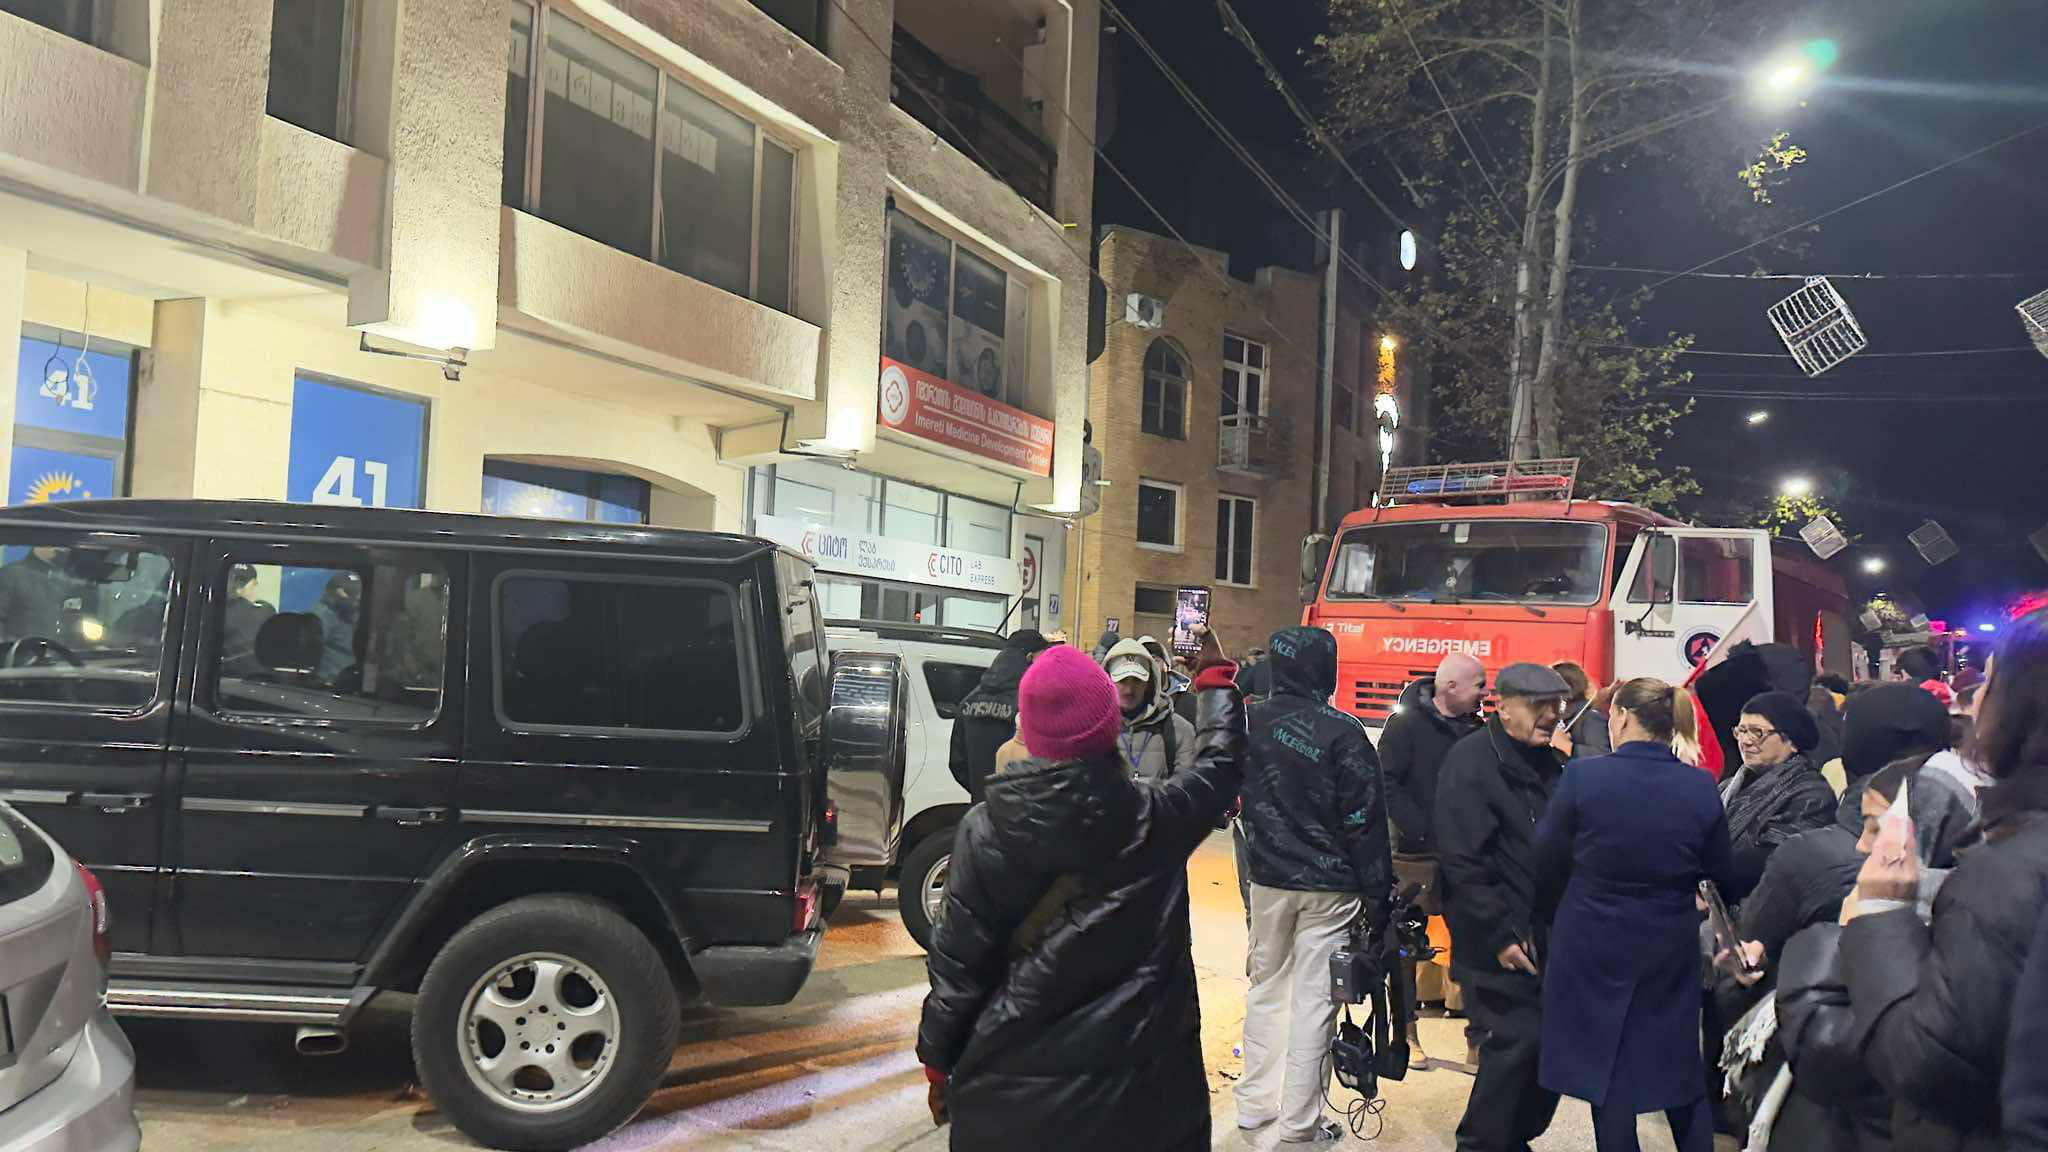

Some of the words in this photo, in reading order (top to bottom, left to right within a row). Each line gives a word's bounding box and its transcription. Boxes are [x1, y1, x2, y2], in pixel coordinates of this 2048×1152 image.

[39, 370, 94, 410] 41
[915, 411, 944, 433] Imereti
[946, 421, 980, 445] Medicine
[981, 433, 1025, 460] Development
[313, 456, 389, 508] 41
[940, 554, 962, 576] CITO
[1107, 619, 1118, 632] 27
